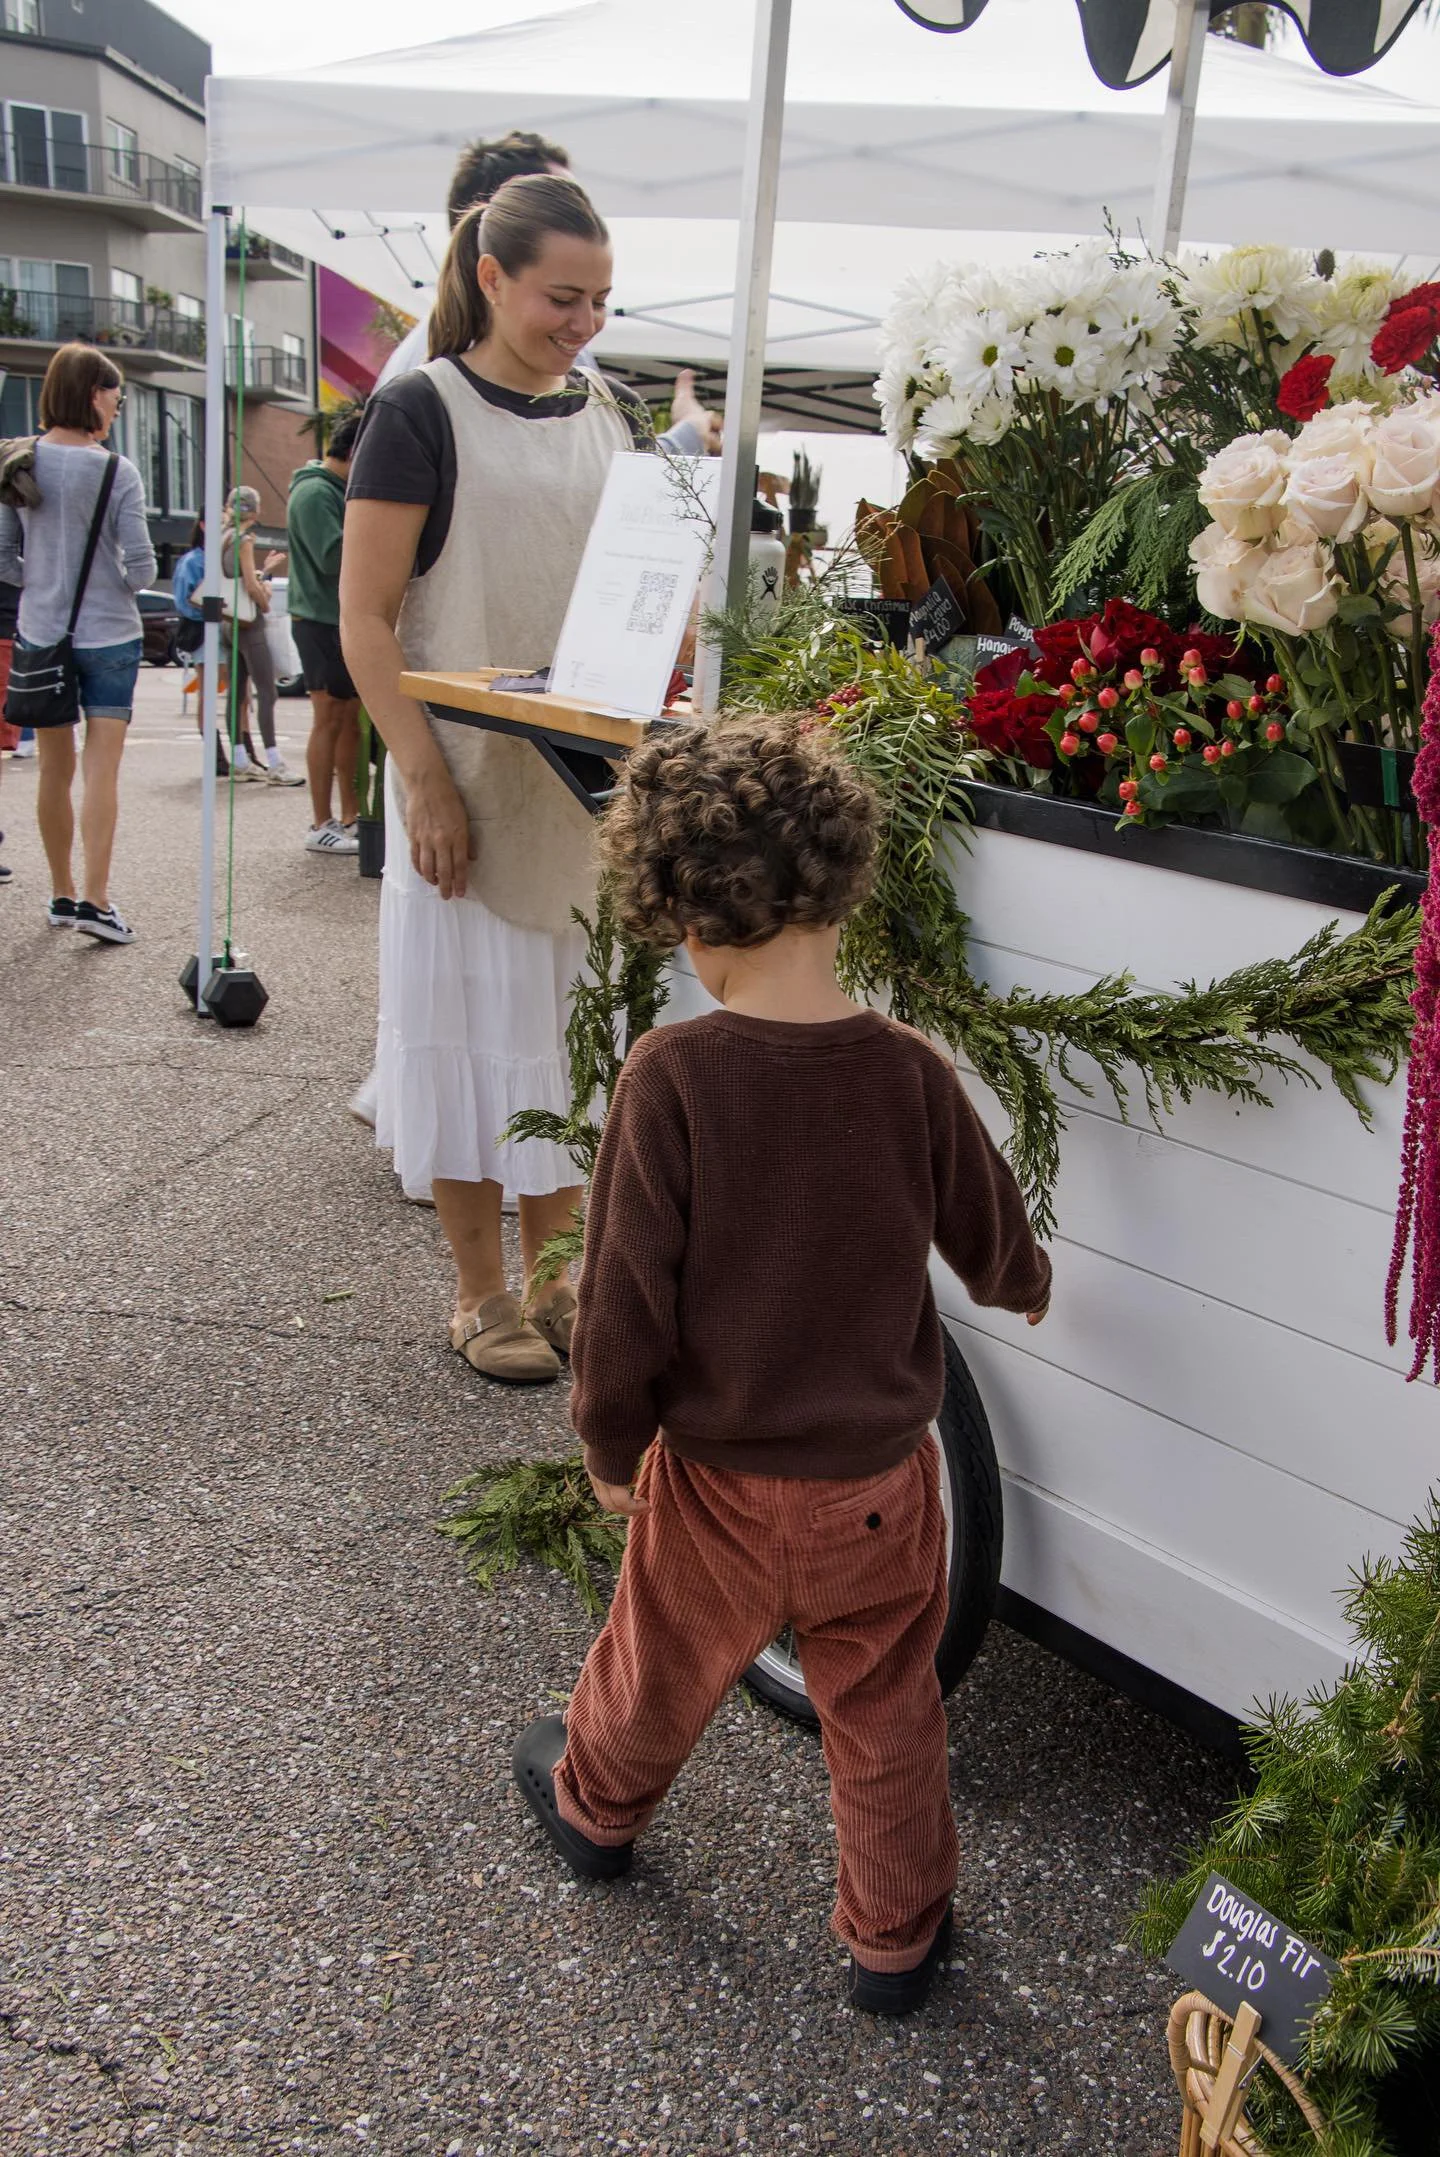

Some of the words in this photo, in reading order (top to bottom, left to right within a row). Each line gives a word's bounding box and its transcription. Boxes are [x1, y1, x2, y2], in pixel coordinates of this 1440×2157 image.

[909, 591, 942, 627] Magnolia
[1206, 1884, 1279, 1948] Douglas
[1280, 1935, 1321, 1978] Fir
